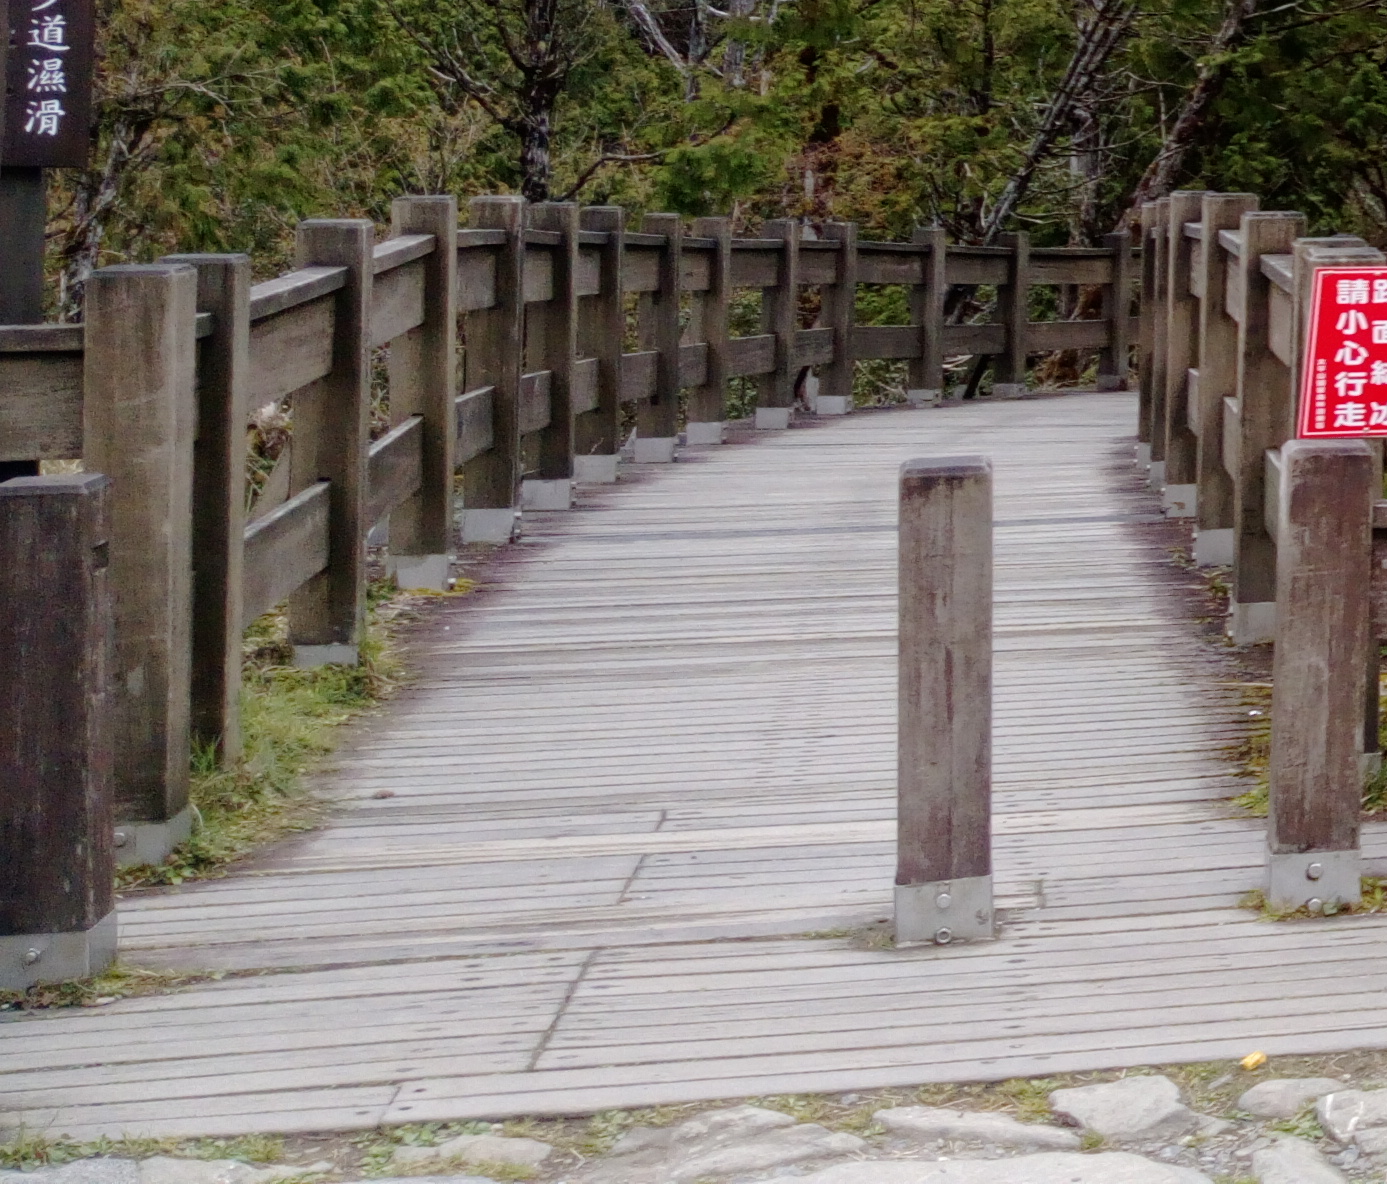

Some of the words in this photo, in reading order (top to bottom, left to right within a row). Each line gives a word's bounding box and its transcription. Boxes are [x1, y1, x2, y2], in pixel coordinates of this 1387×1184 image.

[1333, 278, 1370, 428] 請小心行走
